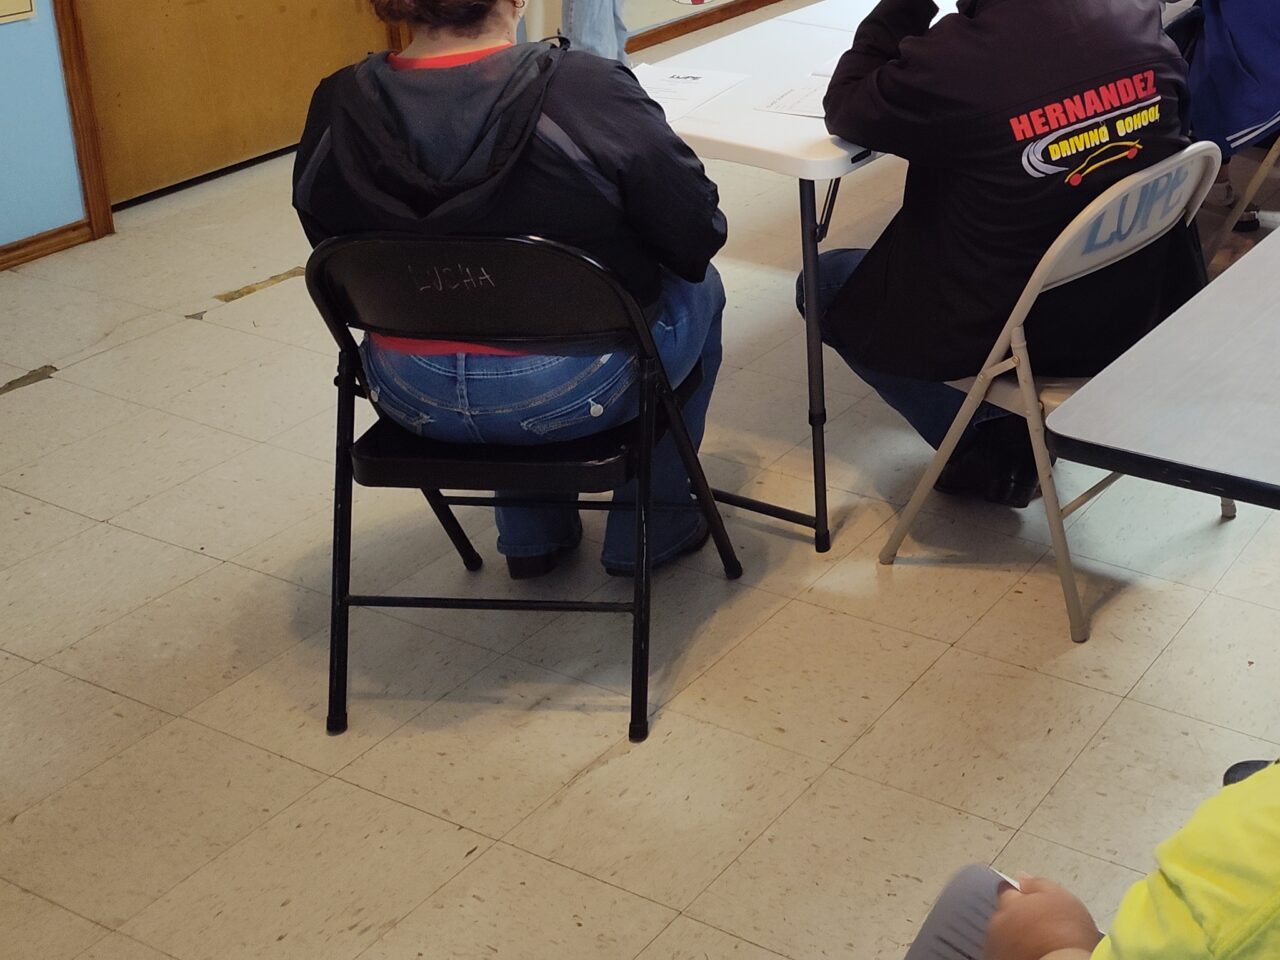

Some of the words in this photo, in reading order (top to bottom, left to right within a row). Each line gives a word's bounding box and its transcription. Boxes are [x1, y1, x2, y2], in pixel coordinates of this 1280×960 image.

[1009, 70, 1157, 141] HERNANDEZ
[1048, 124, 1110, 161] DRIVING
[1115, 104, 1161, 137] SCHOOL
